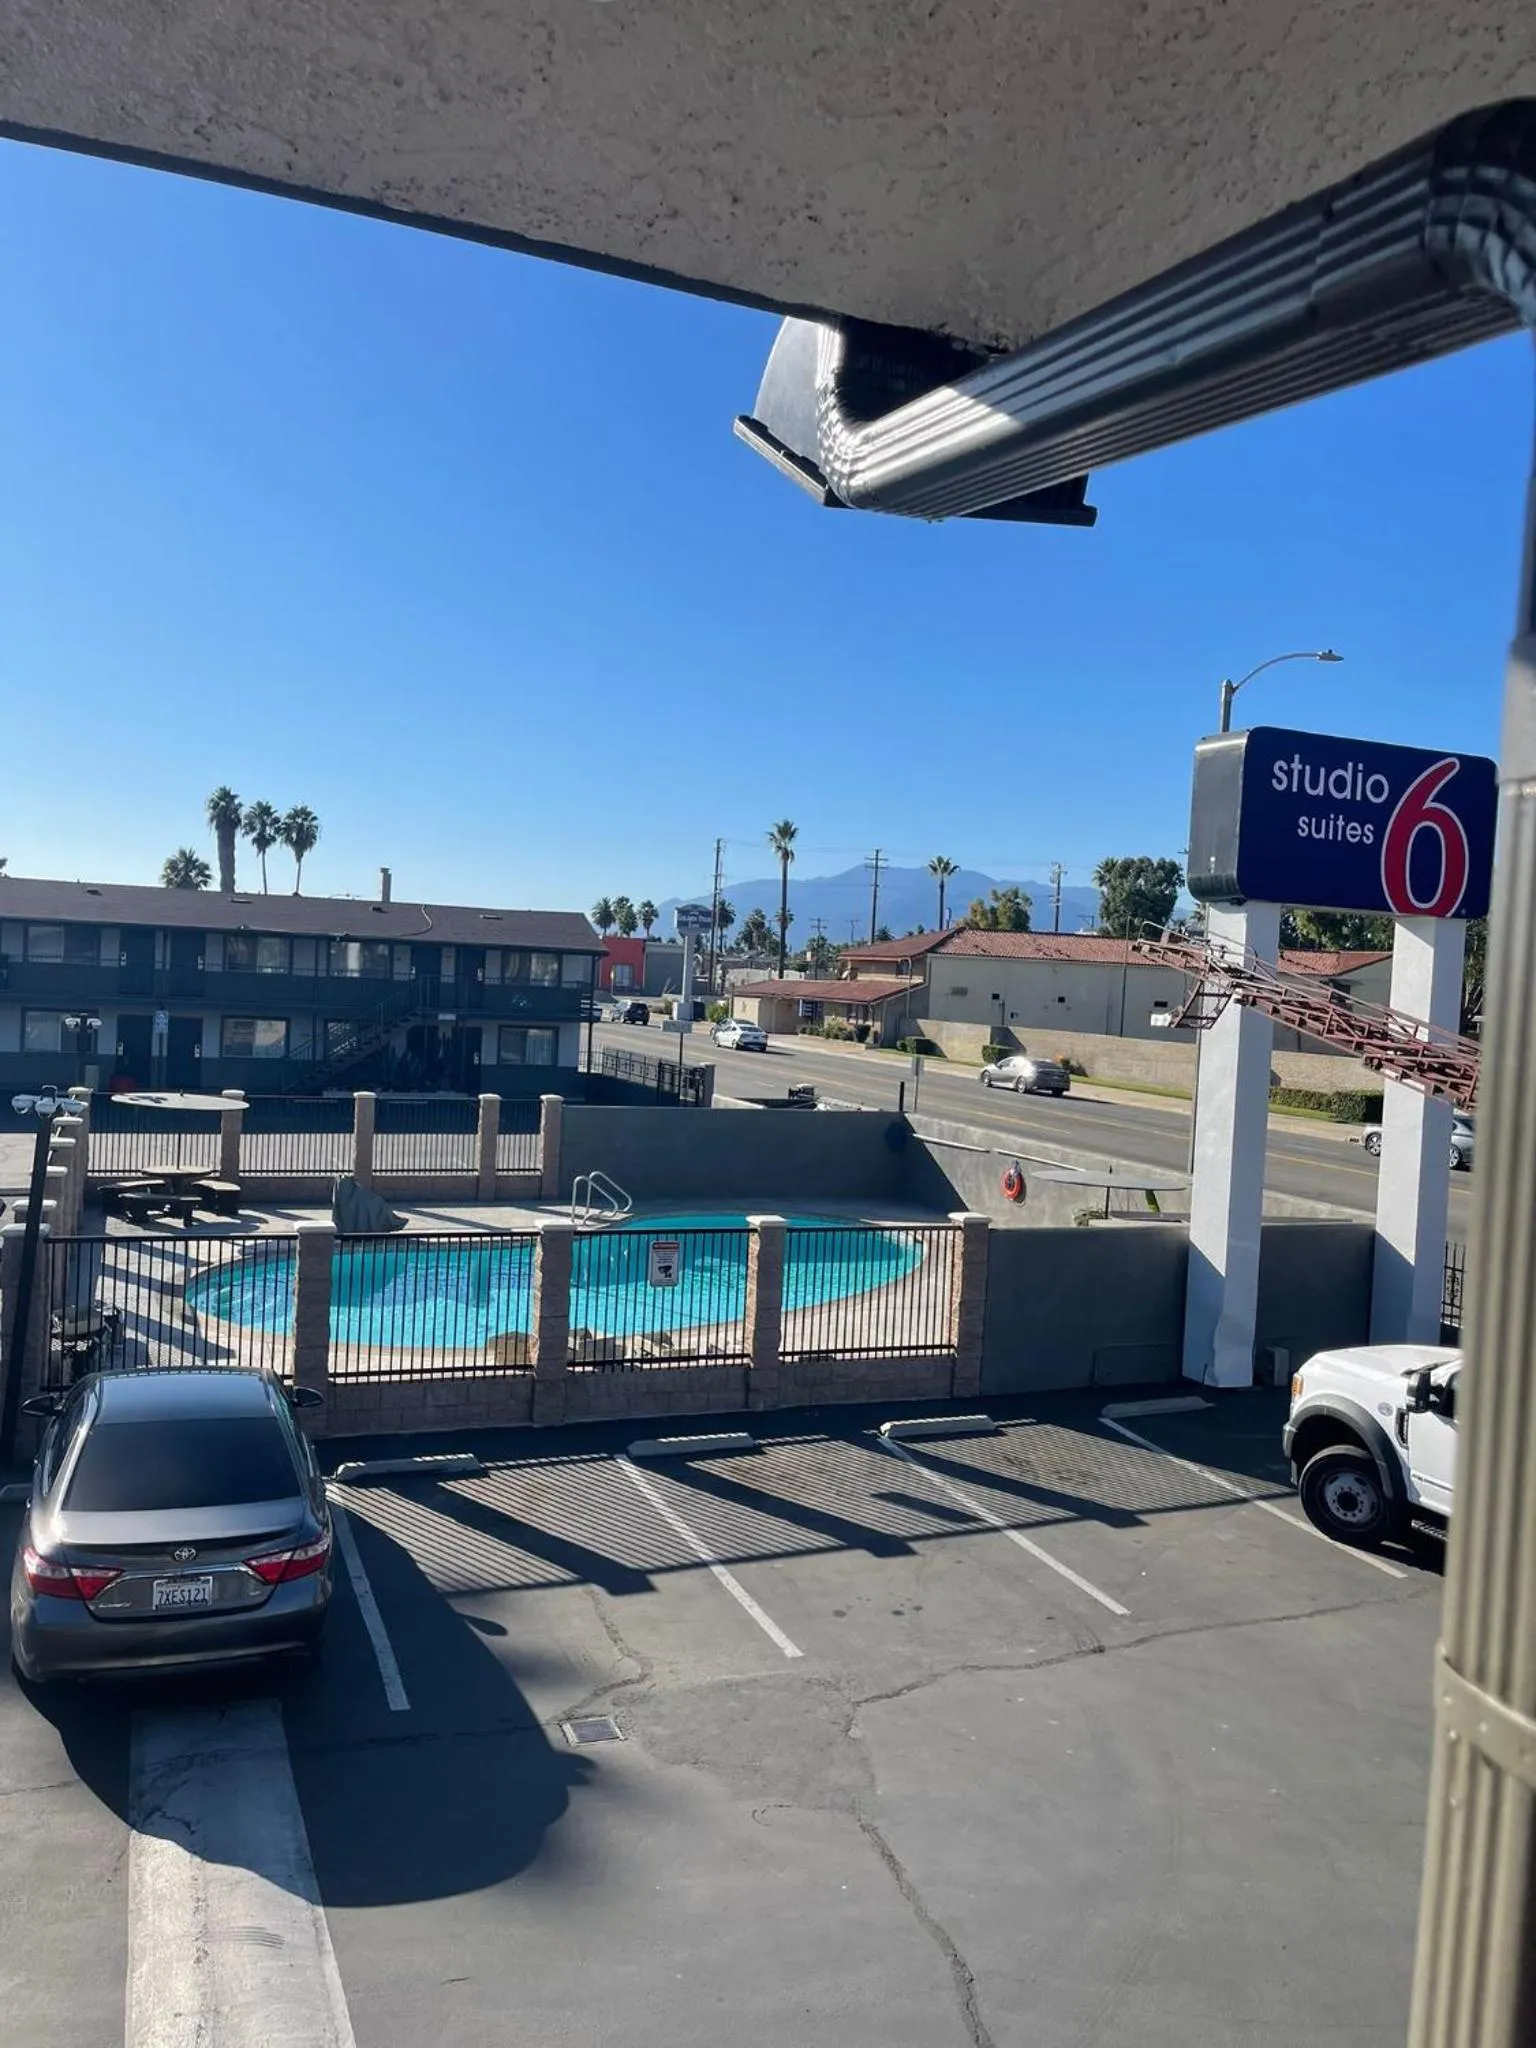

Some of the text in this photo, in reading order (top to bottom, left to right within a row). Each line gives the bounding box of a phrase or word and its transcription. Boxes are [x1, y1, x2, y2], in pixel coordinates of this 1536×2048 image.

[1271, 754, 1469, 918] studio 6
[1297, 813, 1374, 845] suites
